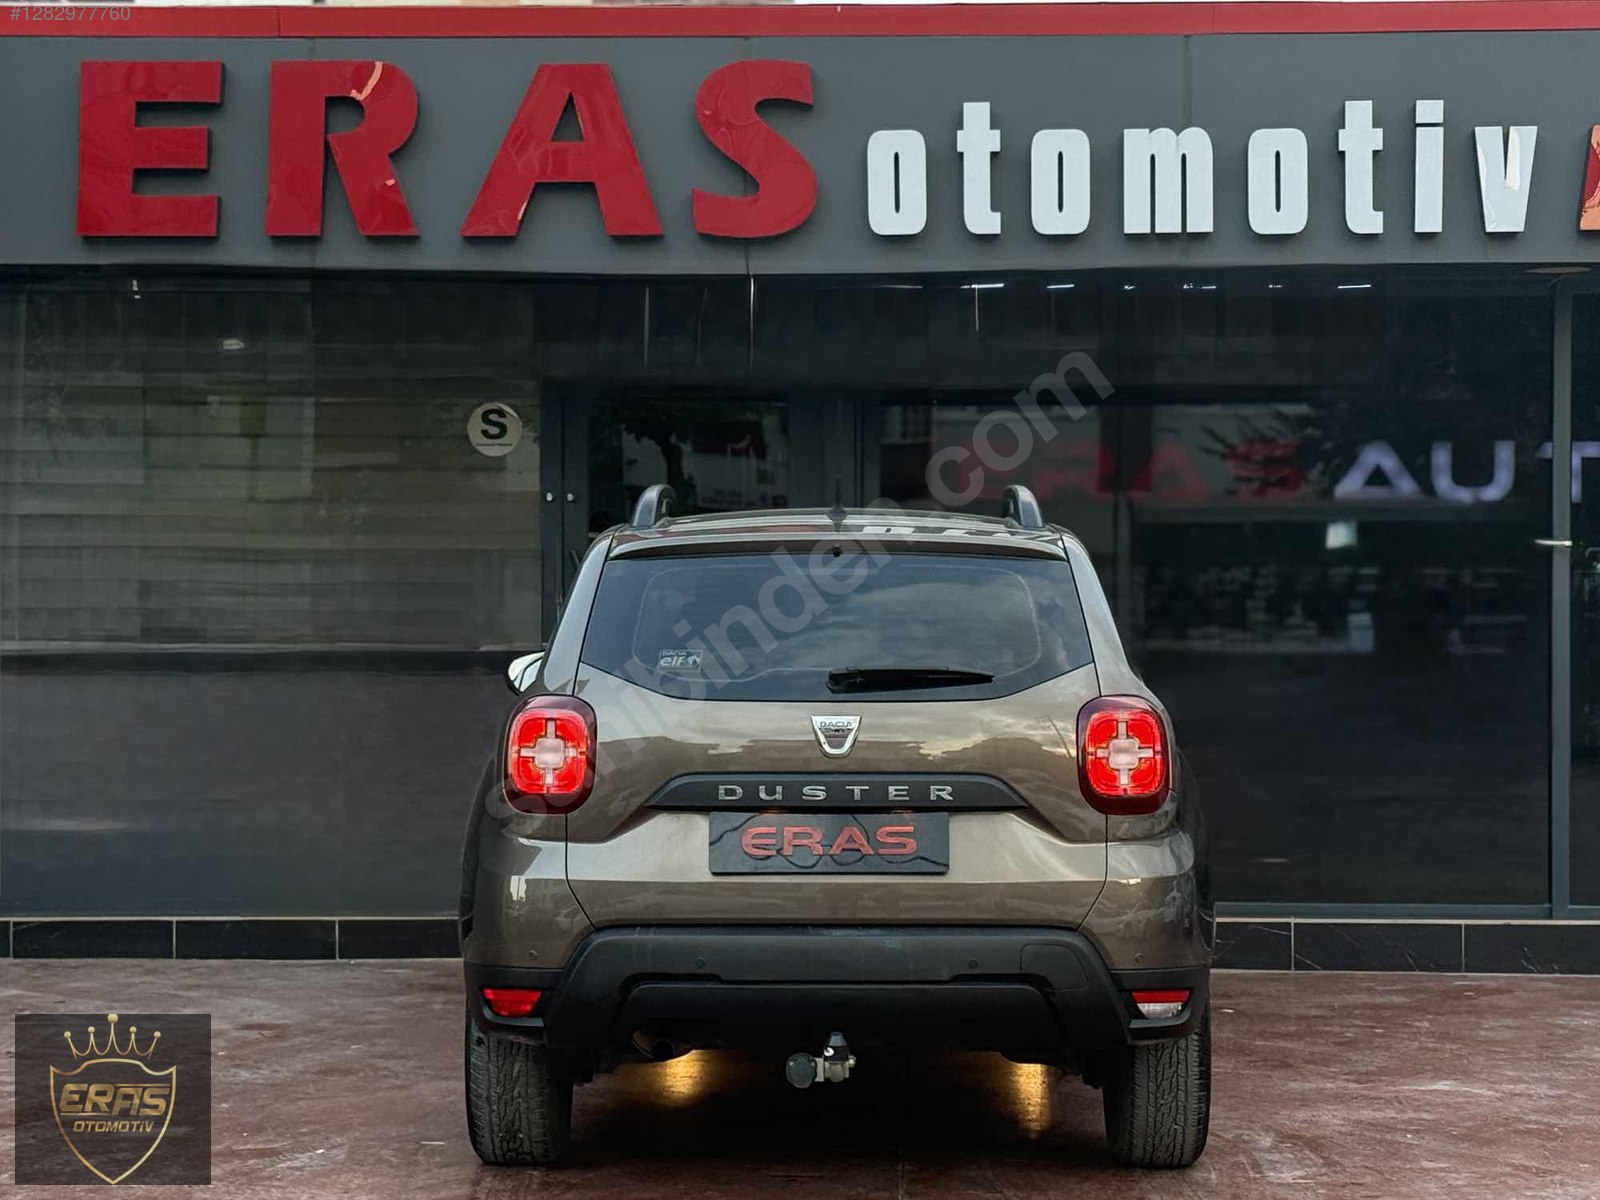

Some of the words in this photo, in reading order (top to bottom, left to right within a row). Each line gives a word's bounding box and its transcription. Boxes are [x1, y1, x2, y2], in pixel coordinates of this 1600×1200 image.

[77, 60, 818, 238] ERAS
[866, 99, 1538, 236] otomotiv
[481, 408, 508, 440] S
[717, 785, 954, 801] DUSTER
[741, 826, 918, 856] ERAS
